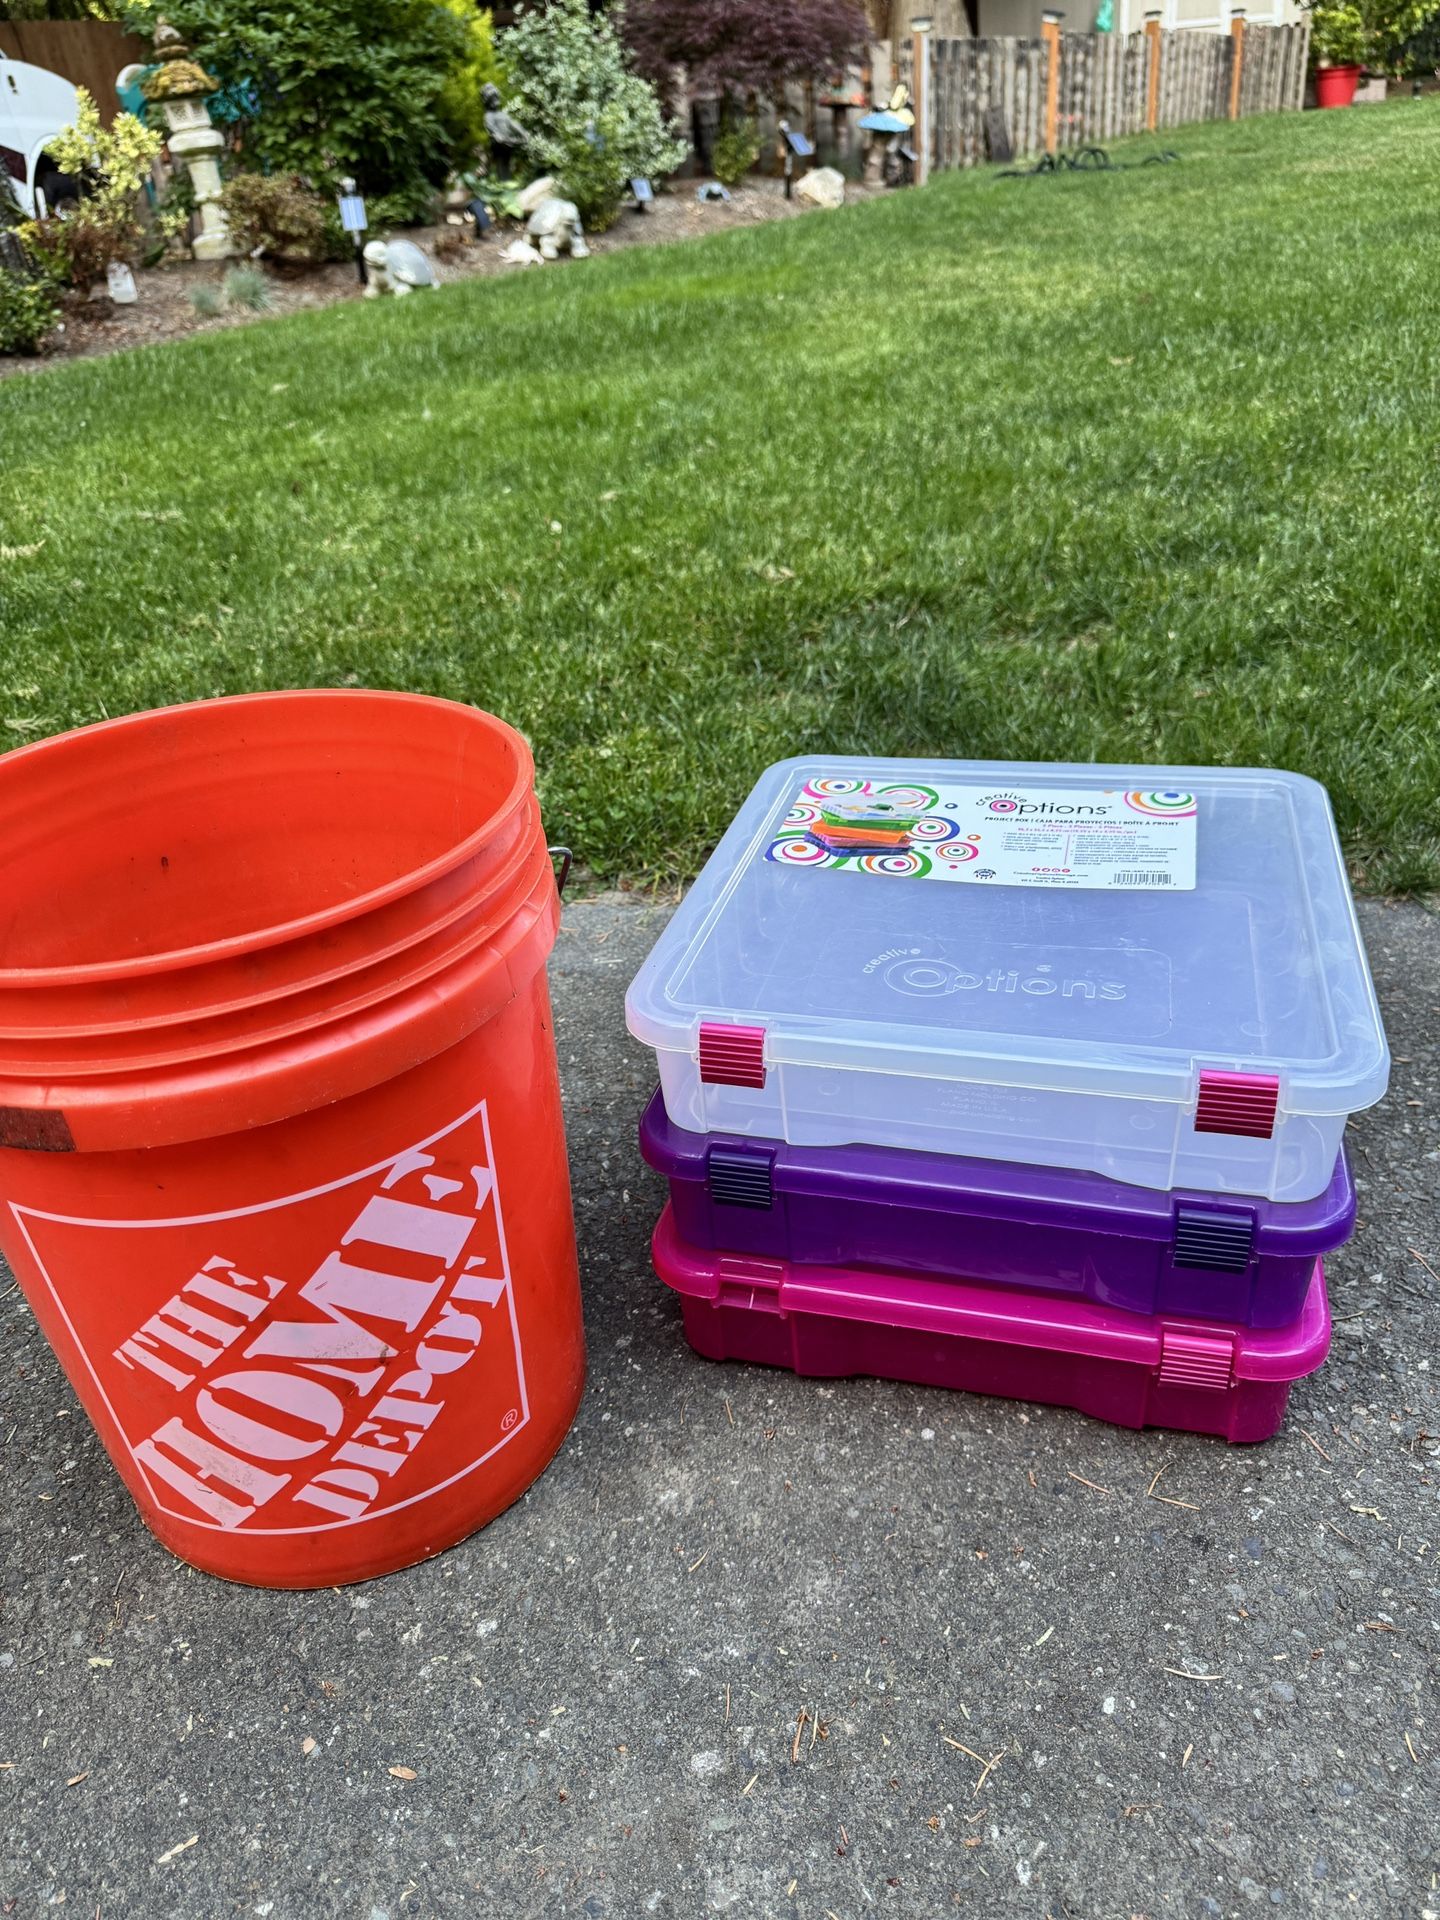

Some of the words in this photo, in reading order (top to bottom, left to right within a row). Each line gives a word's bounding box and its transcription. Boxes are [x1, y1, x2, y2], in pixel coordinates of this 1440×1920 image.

[976, 792, 1027, 806] creative
[989, 799, 1107, 815] Options
[862, 947, 921, 974] creative
[898, 963, 1127, 1000] Options
[113, 1254, 288, 1392] THE
[133, 1150, 493, 1529] HOME
[292, 1256, 508, 1519] DEPOT
